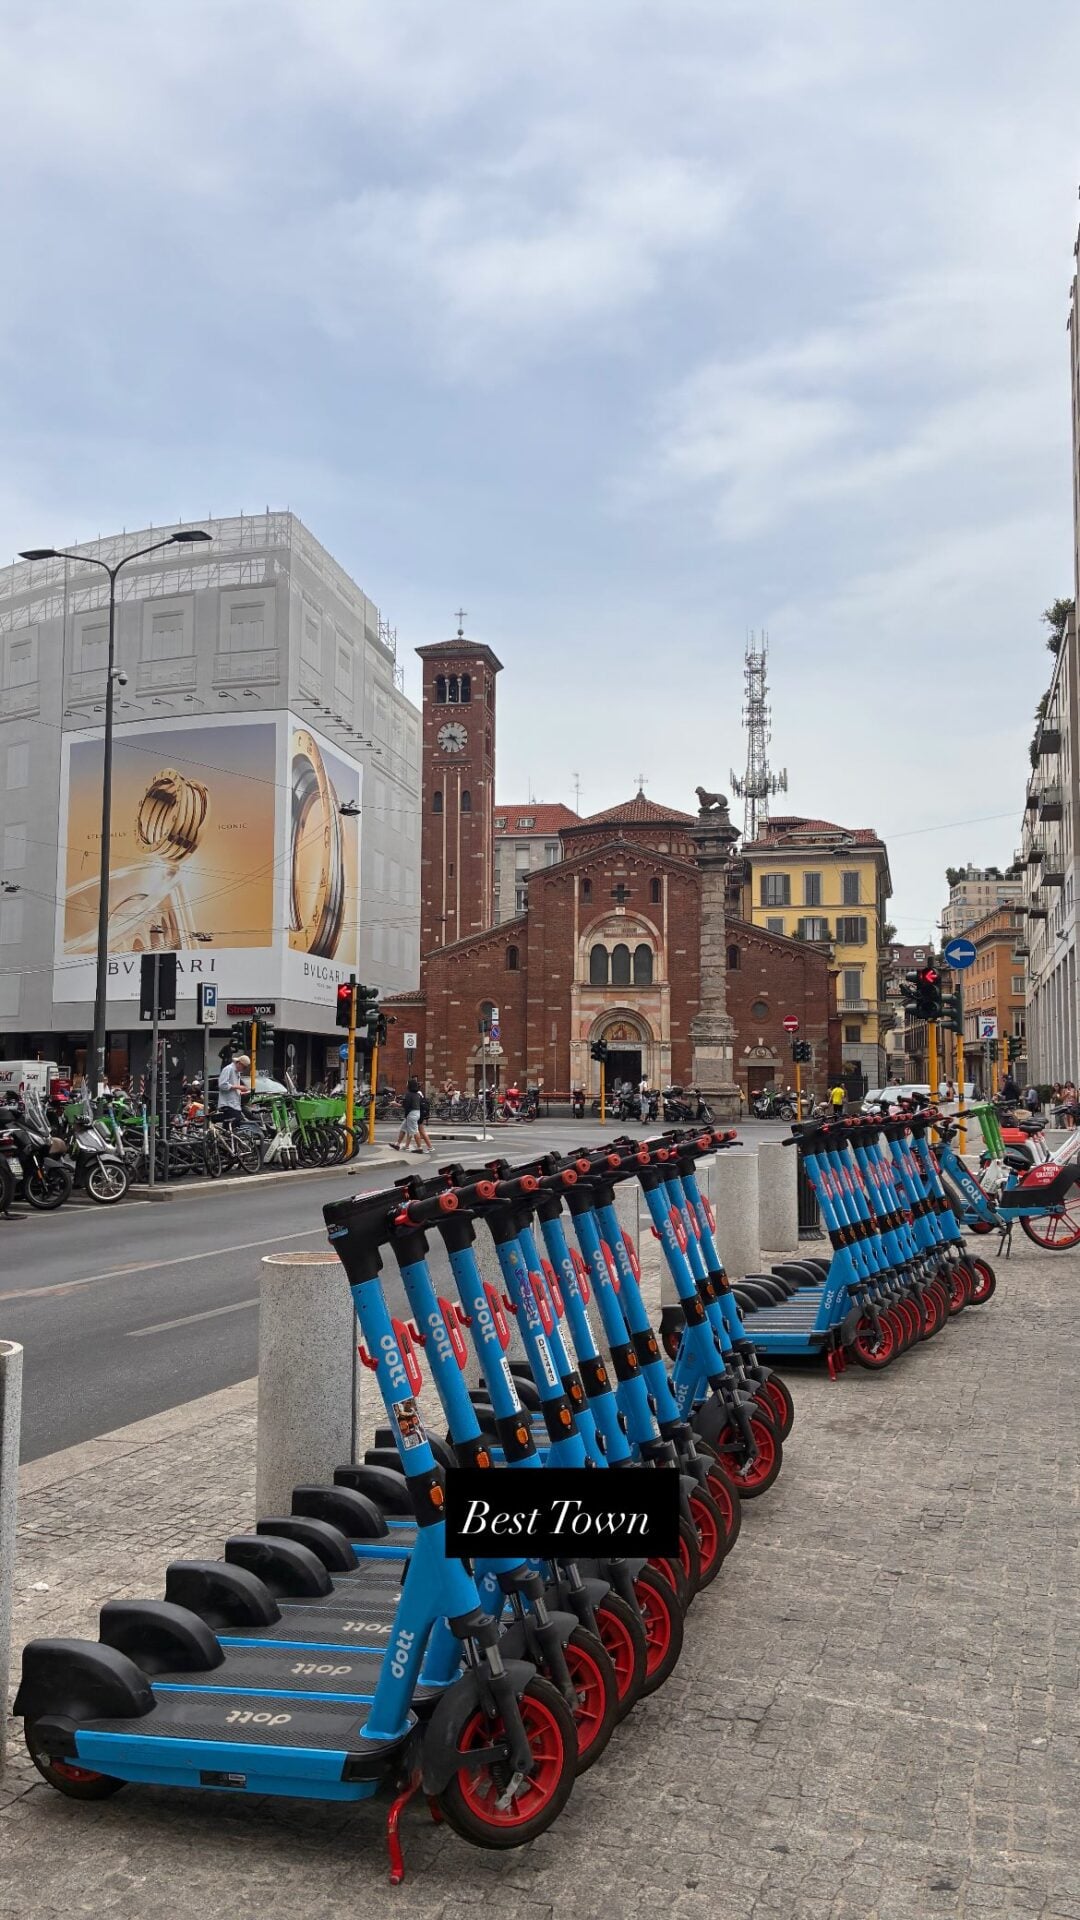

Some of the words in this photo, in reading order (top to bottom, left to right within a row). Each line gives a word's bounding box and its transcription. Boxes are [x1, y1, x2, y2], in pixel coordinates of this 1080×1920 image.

[108, 958, 216, 975] BVARI
[303, 962, 344, 983] BVLGARI
[961, 1178, 982, 1204] dott
[593, 1250, 611, 1287] dott
[615, 1240, 632, 1276] dott
[824, 1290, 835, 1310] dott
[472, 1297, 497, 1343] dott
[428, 1312, 454, 1362] dott
[380, 1334, 407, 1388] dott
[290, 1662, 353, 1677] dott
[391, 1629, 415, 1679] dott
[225, 1709, 293, 1726] dott
